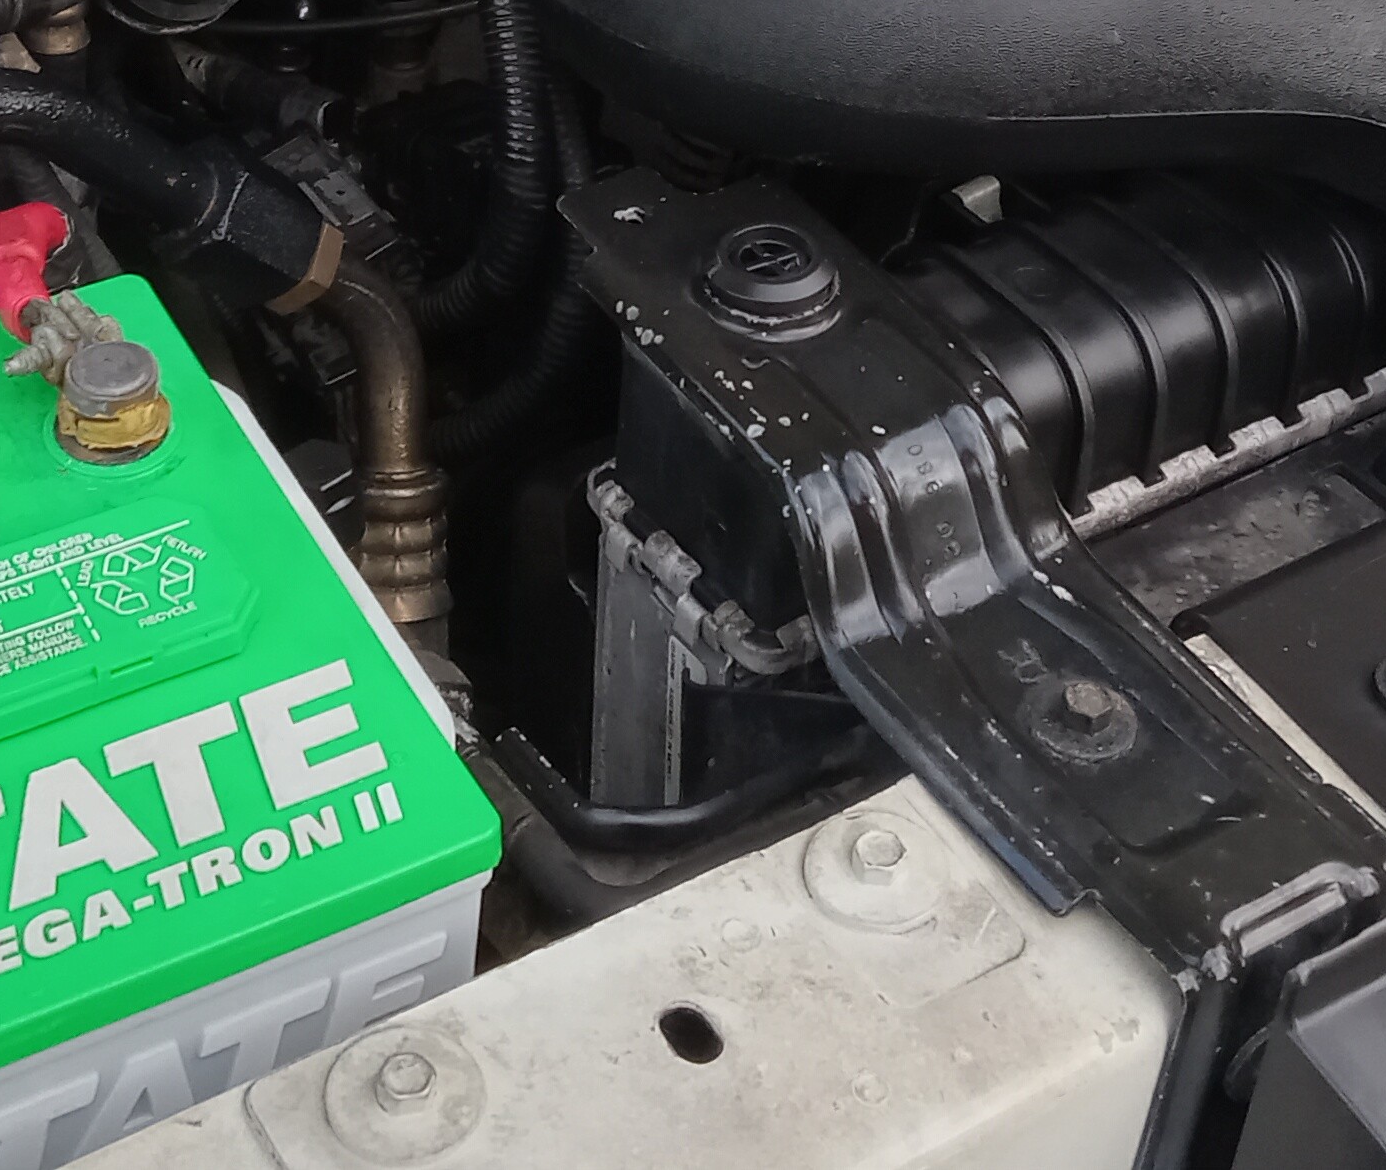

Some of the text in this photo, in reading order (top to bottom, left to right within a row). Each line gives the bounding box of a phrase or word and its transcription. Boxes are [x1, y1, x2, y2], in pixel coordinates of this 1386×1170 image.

[12, 551, 29, 564] OF
[32, 532, 94, 557] CHILDREN
[18, 553, 55, 574] TIGHT
[59, 546, 85, 562] AND
[161, 534, 208, 561] RETURN
[76, 559, 94, 588] LEAD
[138, 601, 197, 629] RECYCLE
[26, 617, 75, 643] FOLLOW
[352, 782, 403, 833] II
